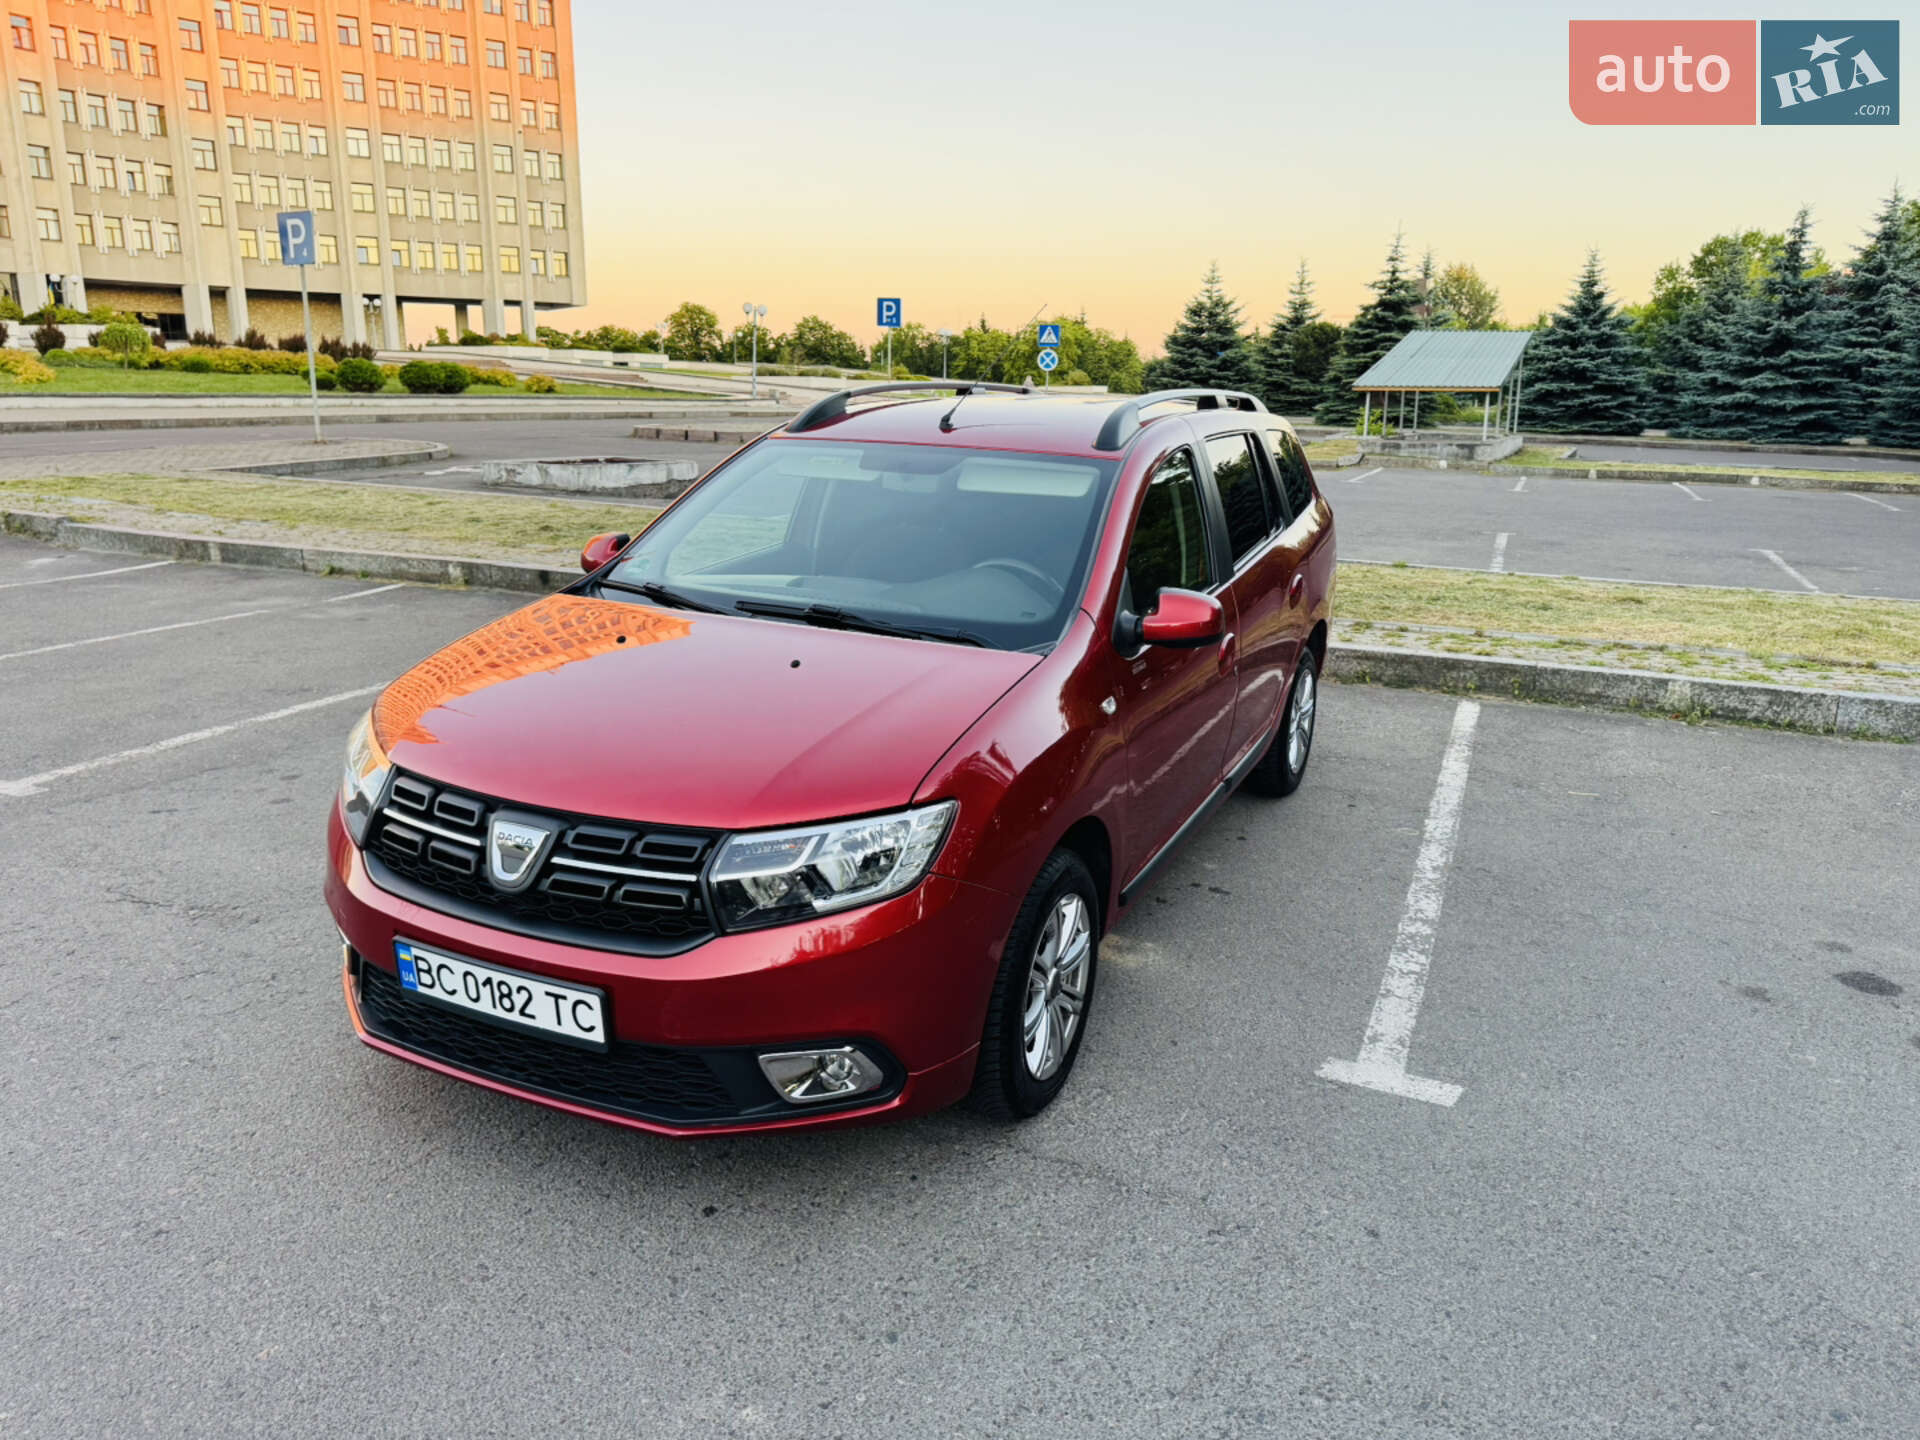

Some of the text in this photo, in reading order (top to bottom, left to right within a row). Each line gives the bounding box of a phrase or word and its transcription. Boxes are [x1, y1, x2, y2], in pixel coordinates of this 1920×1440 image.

[286, 218, 306, 259] P
[882, 301, 896, 324] P
[497, 831, 534, 847] DACIA
[402, 970, 416, 983] UA
[414, 955, 597, 1033] BC 0182 TC
